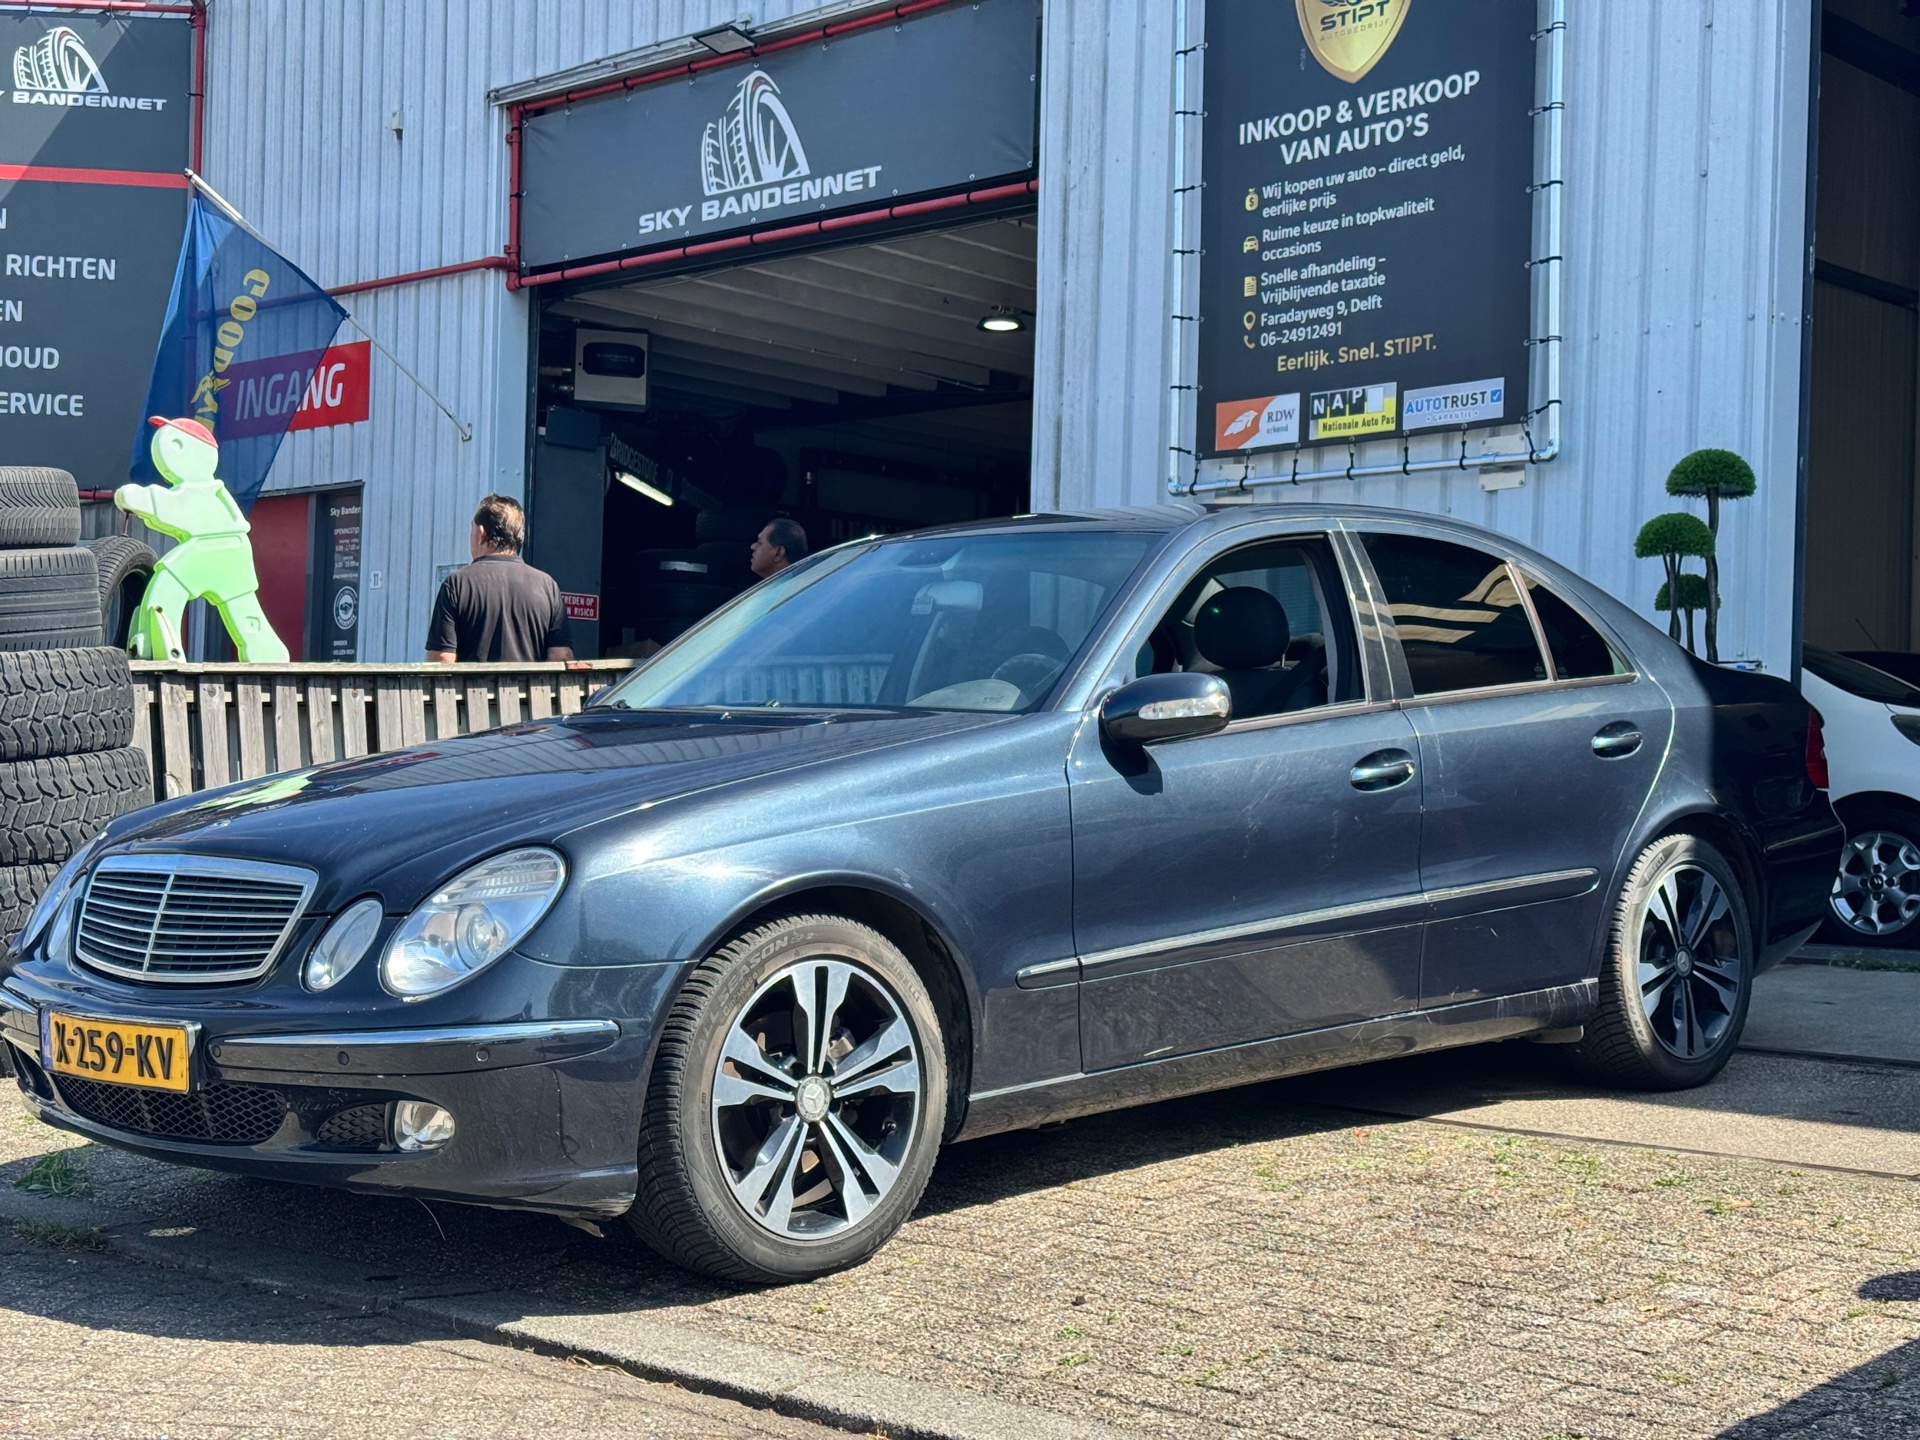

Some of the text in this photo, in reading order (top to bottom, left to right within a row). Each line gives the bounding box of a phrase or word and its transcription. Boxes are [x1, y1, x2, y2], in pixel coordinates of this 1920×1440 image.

[1320, 0, 1391, 32] STIPT
[1320, 18, 1391, 42] AUTOBEDRIJF
[12, 91, 168, 112] BANDENNET
[1239, 70, 1481, 145] INKOOP & VERKOOP
[1280, 134, 1331, 165] VAN
[1262, 184, 1283, 200] Wij
[1285, 178, 1324, 198] kopen
[1326, 172, 1345, 187] uw
[1347, 166, 1377, 182] auto
[1388, 153, 1428, 174] direct
[1430, 144, 1466, 168] geld,
[638, 165, 883, 235] SKY BANDENNET
[1262, 191, 1337, 219] eerlijke prijs
[1262, 198, 1435, 242] Ruime keuze in topkwaliteit
[1262, 240, 1322, 261] occasions
[5, 254, 117, 281] RICHTEN
[1261, 266, 1298, 287] Snelle
[1300, 256, 1376, 280] afhandeling
[1261, 271, 1386, 305] Vrijblijvende taxatie
[0, 299, 23, 322] N
[1260, 294, 1383, 327] Faradayweg 9, Delft
[1260, 321, 1342, 347] 06-24912491
[0, 346, 60, 370] OUD
[1277, 334, 1437, 372] Eerlijk. Snel. STIPT.
[234, 362, 346, 422] INGANG
[1405, 391, 1488, 415] AUTOTRUST
[1266, 408, 1296, 423] RDW
[1266, 424, 1289, 434] erkend
[1322, 415, 1395, 433] Nationale Auto Pas
[330, 507, 341, 518] Sky
[574, 606, 594, 617] RISICO
[586, 597, 595, 607] OP
[718, 935, 789, 1009] SEASON
[54, 1021, 174, 1081] X-259-KV
